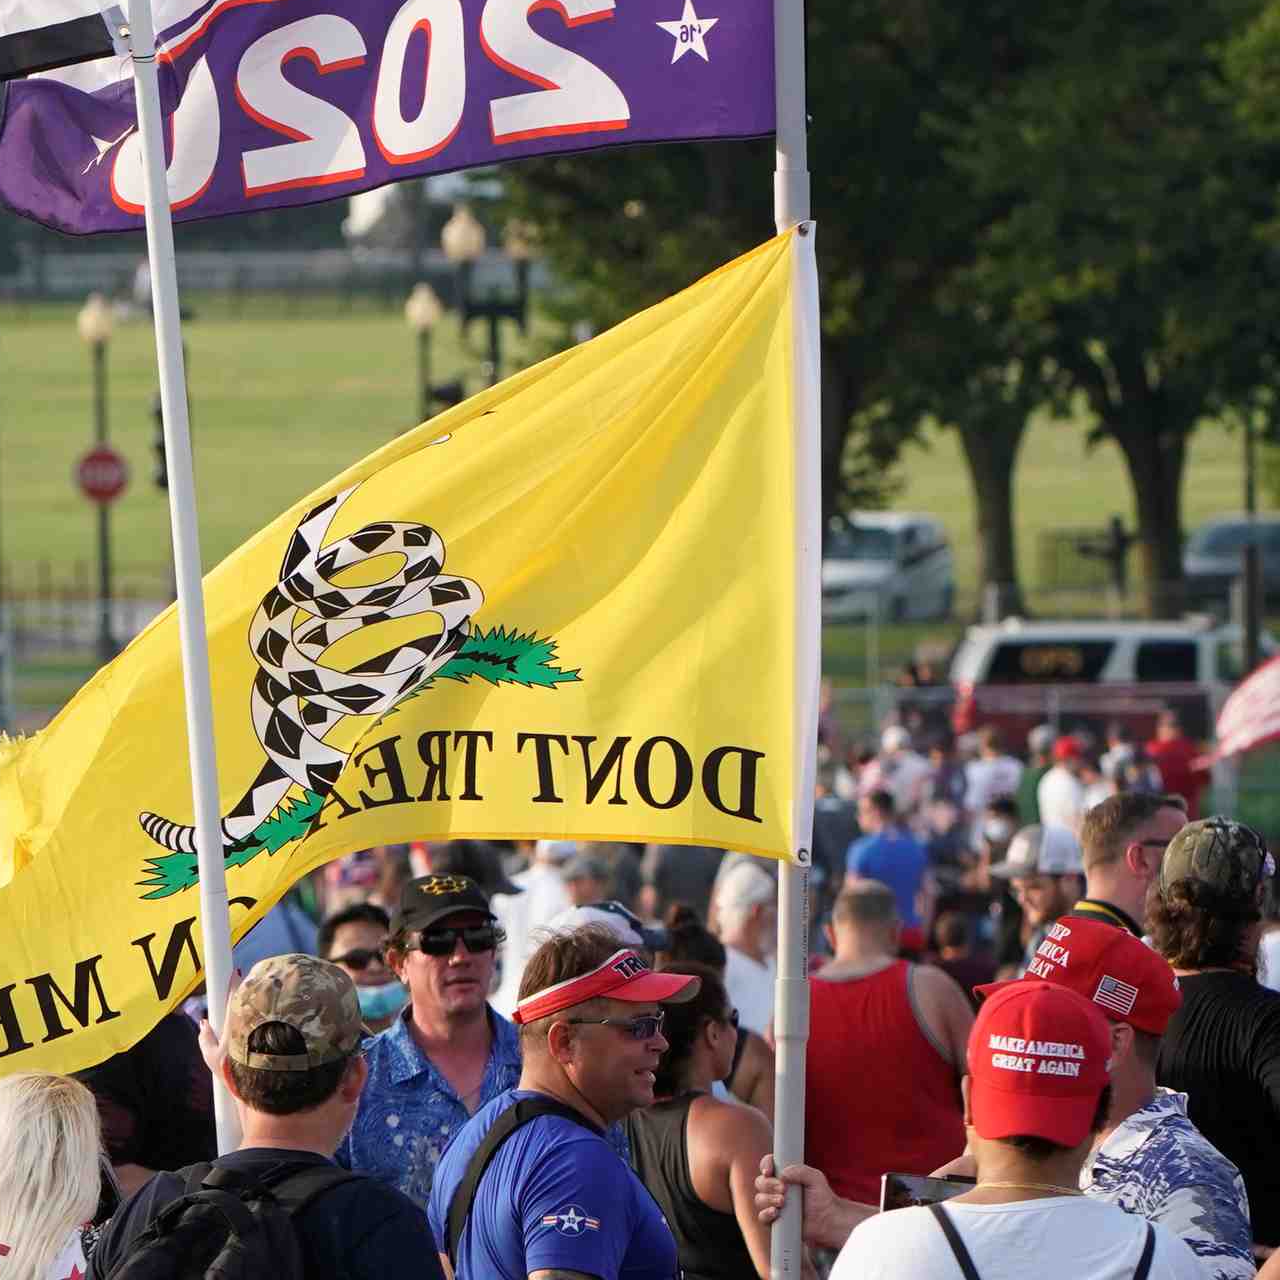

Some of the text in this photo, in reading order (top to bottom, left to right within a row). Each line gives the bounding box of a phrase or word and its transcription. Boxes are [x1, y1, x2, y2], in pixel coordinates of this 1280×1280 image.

[612, 956, 649, 979] TRU
[988, 1033, 1085, 1060] MAKE AMERICA
[991, 1053, 1081, 1077] GREAT AGAIN
